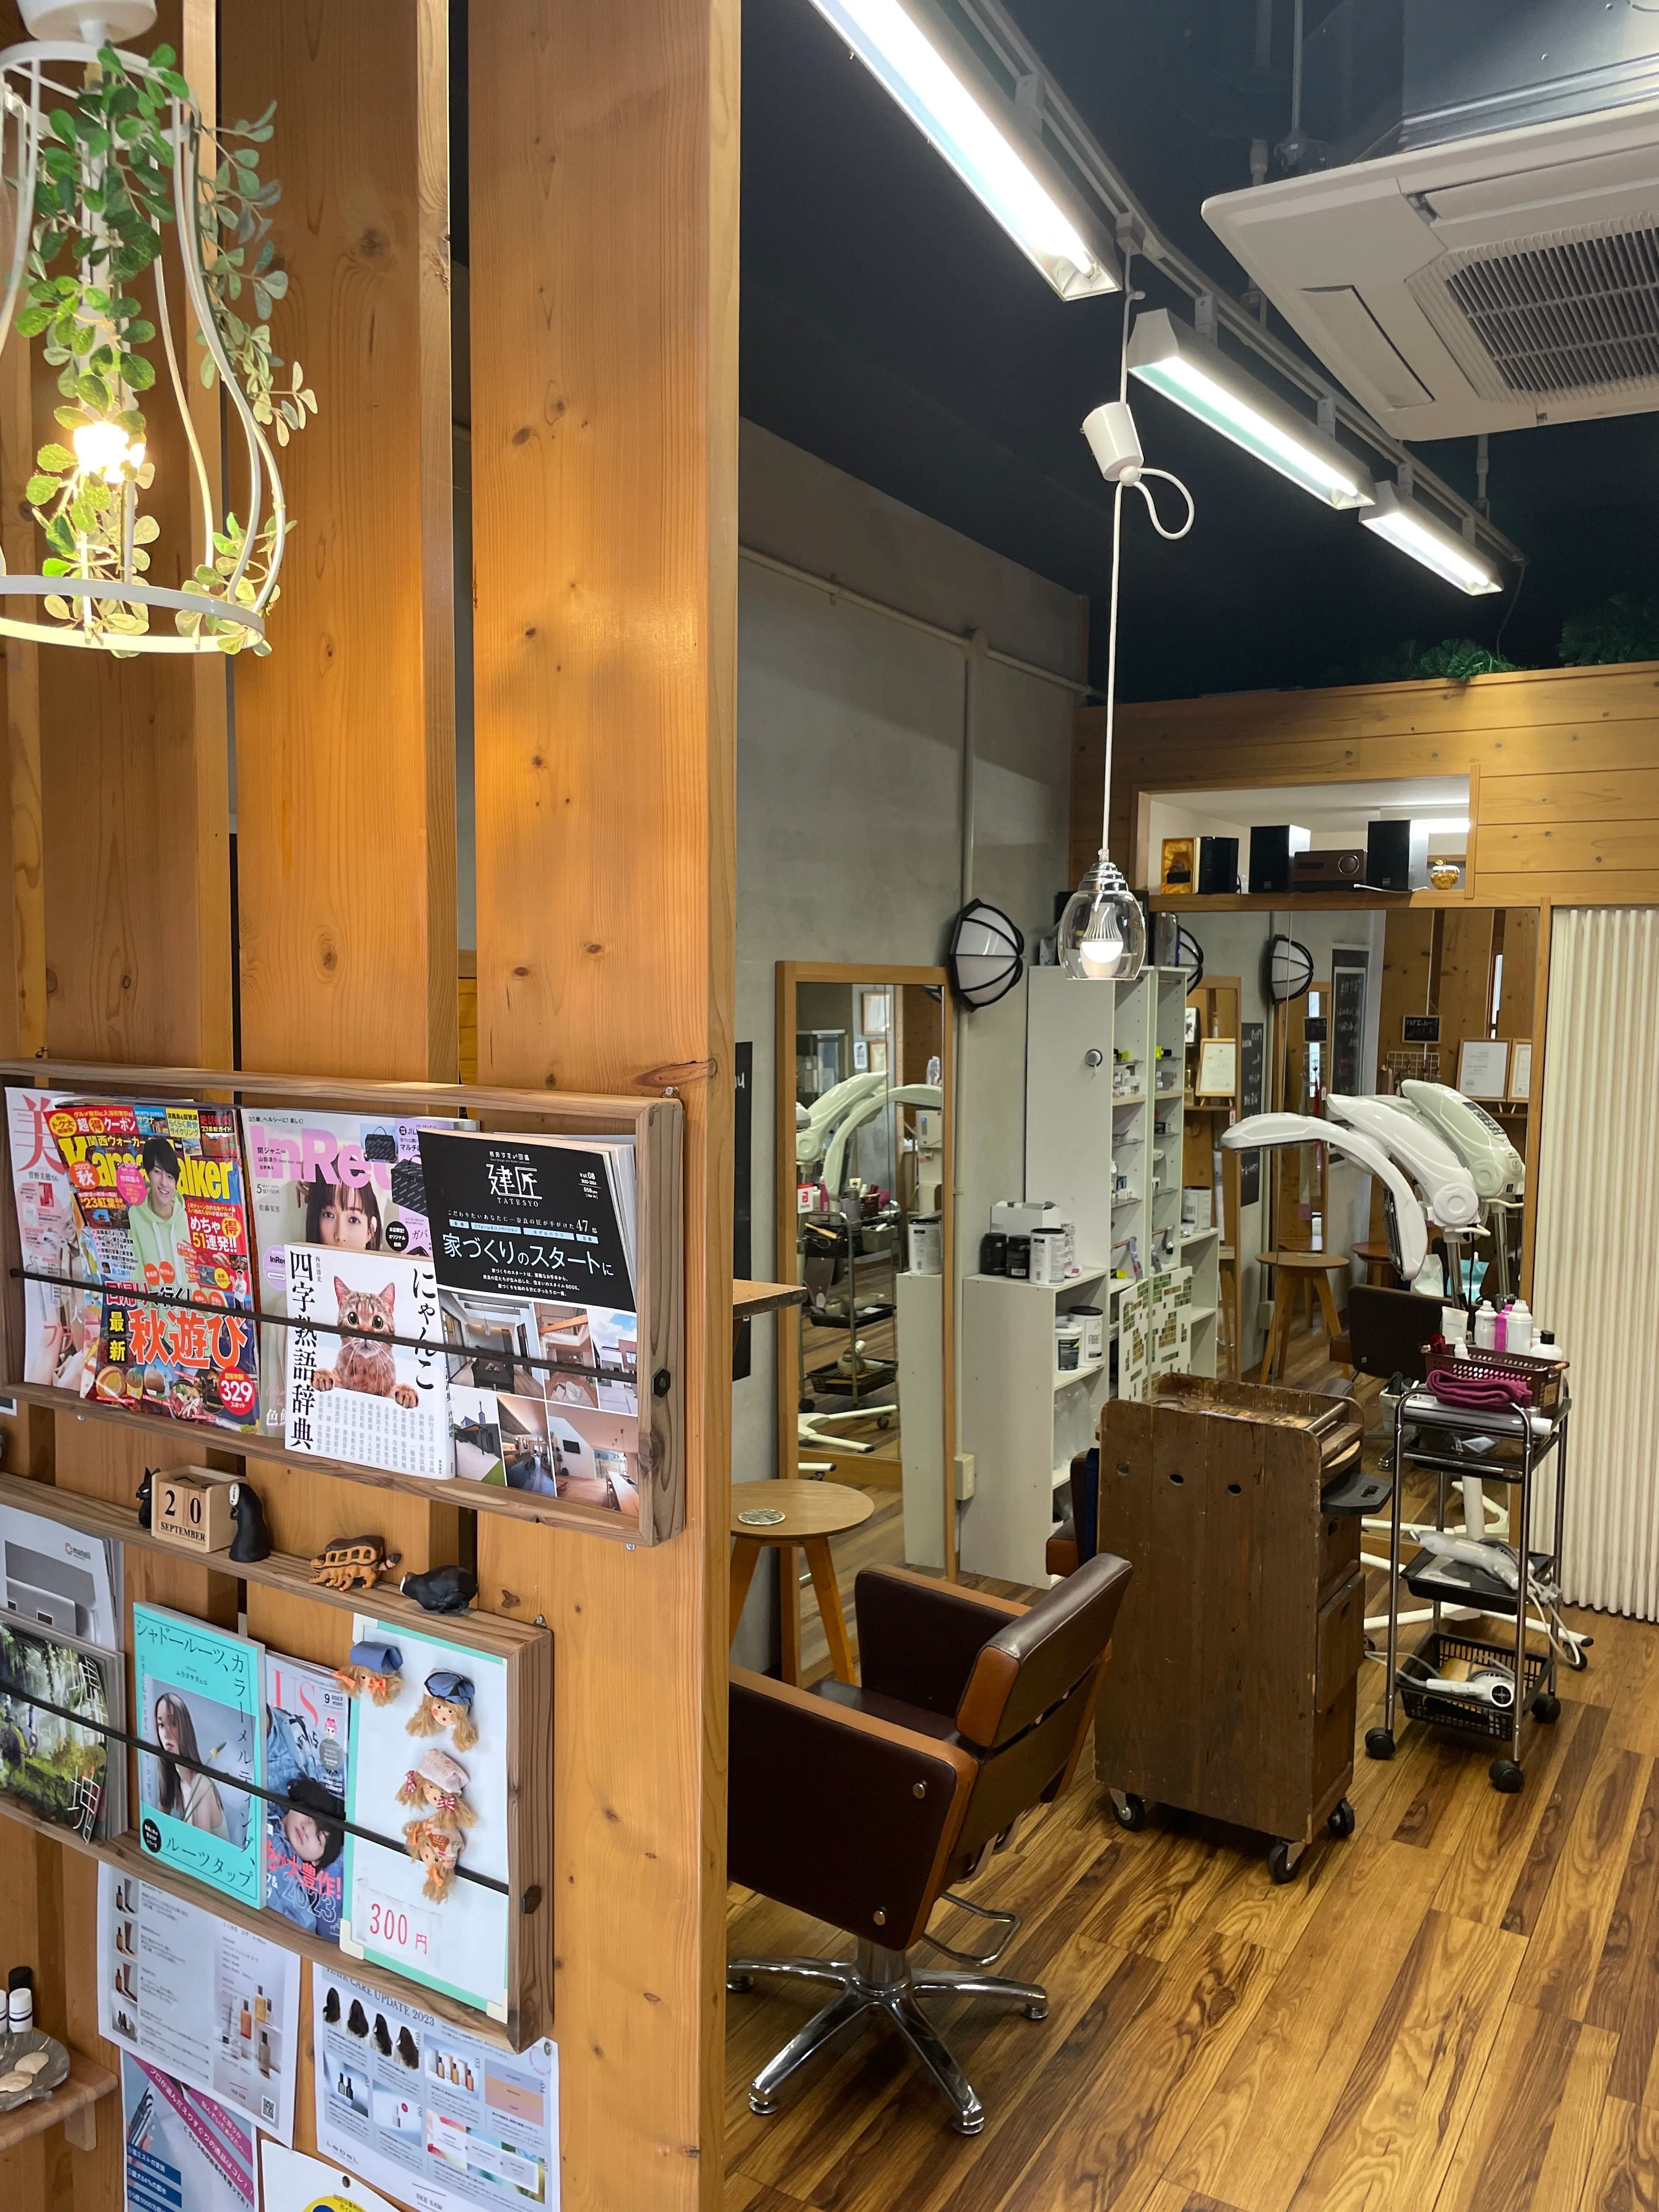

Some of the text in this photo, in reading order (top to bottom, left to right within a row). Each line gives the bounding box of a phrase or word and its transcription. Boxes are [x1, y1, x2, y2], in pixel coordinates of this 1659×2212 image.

[87, 1135, 146, 1147] 関西ウォーカー
[170, 1127, 199, 1136] サイクリング
[77, 1170, 96, 1186] 秋
[257, 1184, 262, 1194] 5
[486, 1163, 543, 1200] 建匠
[259, 1204, 280, 1212] 佐藤栞里
[497, 1197, 539, 1208] TATESYO
[442, 1232, 614, 1276] 家づくりのスタートに
[109, 1311, 126, 1362] 最新
[128, 1308, 248, 1370] 秋遊び
[413, 1268, 436, 1390] にゃんこ
[290, 1250, 317, 1450] 四字熟語辞典
[220, 1380, 253, 1402] 329
[160, 1521, 206, 1543] SEPTEMBER
[137, 1618, 229, 1673] シャドールーツ、
[324, 1694, 330, 1703] 9
[166, 1837, 254, 1888] ルーツタップ
[369, 1903, 428, 1955] 300円
[374, 1989, 410, 2016] UPDATE
[413, 2009, 435, 2027] 2023
